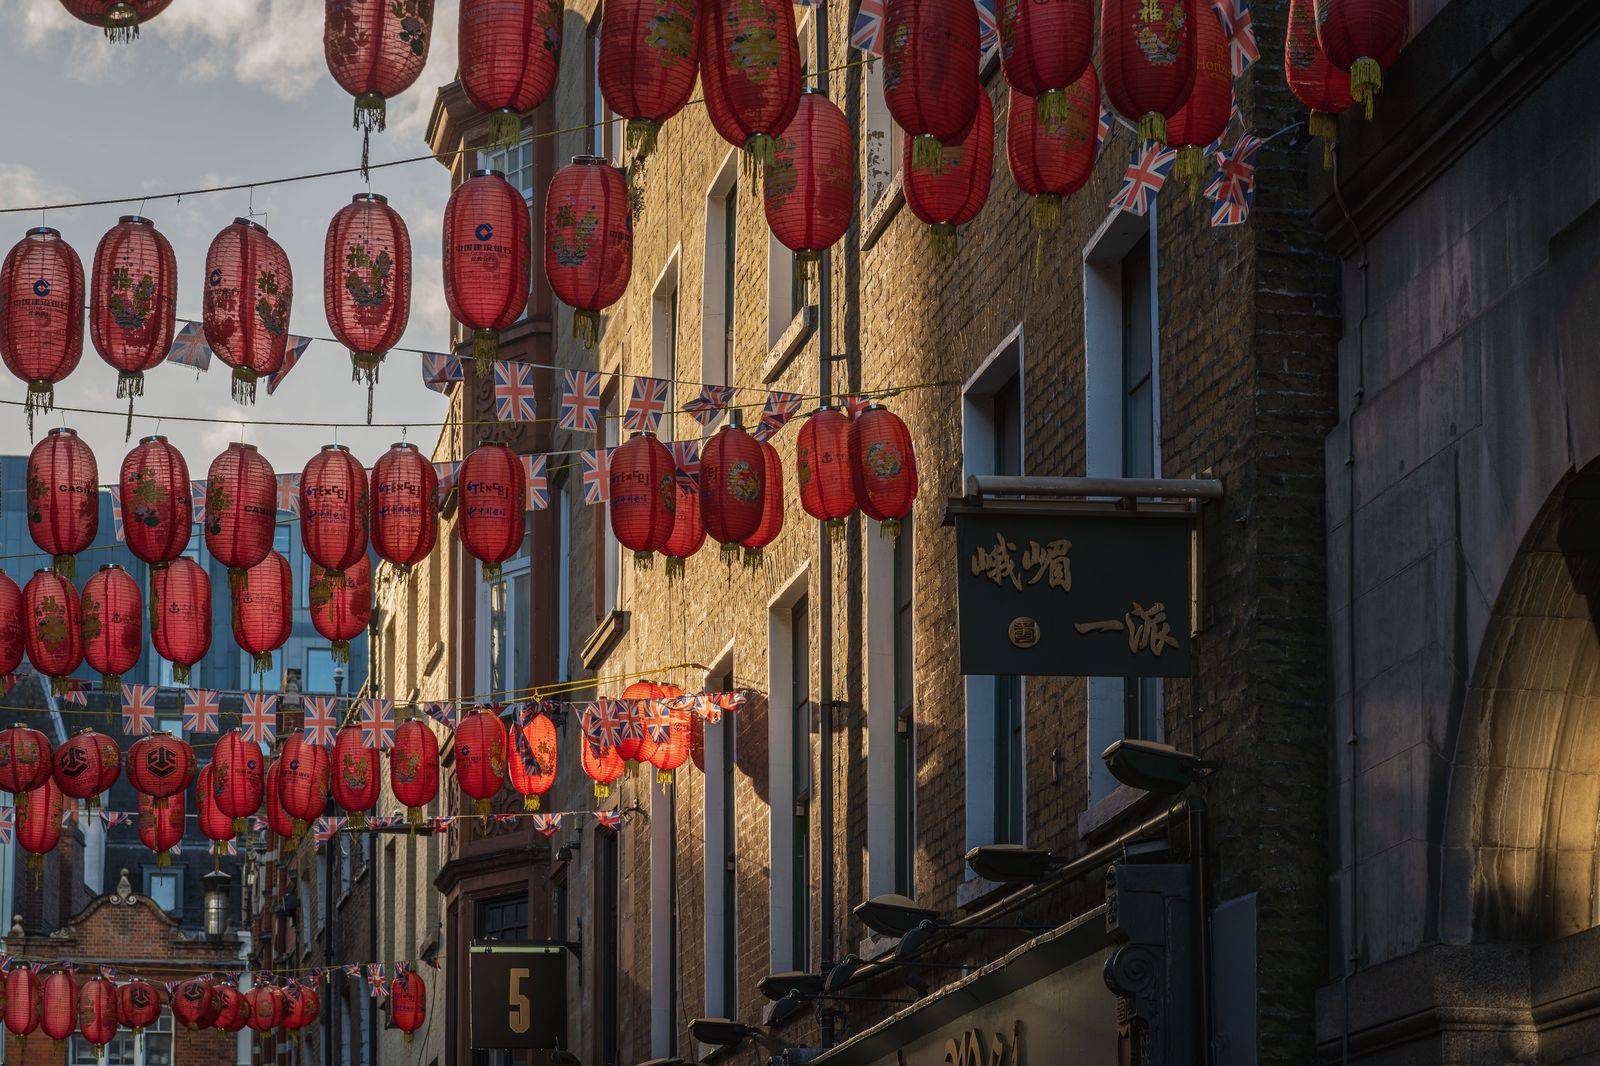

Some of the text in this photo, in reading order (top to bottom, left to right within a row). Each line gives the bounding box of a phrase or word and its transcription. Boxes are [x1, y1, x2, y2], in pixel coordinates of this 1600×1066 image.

[970, 532, 1073, 593] 峨嵋
[1074, 601, 1180, 657] 一派
[509, 967, 531, 1034] 5
